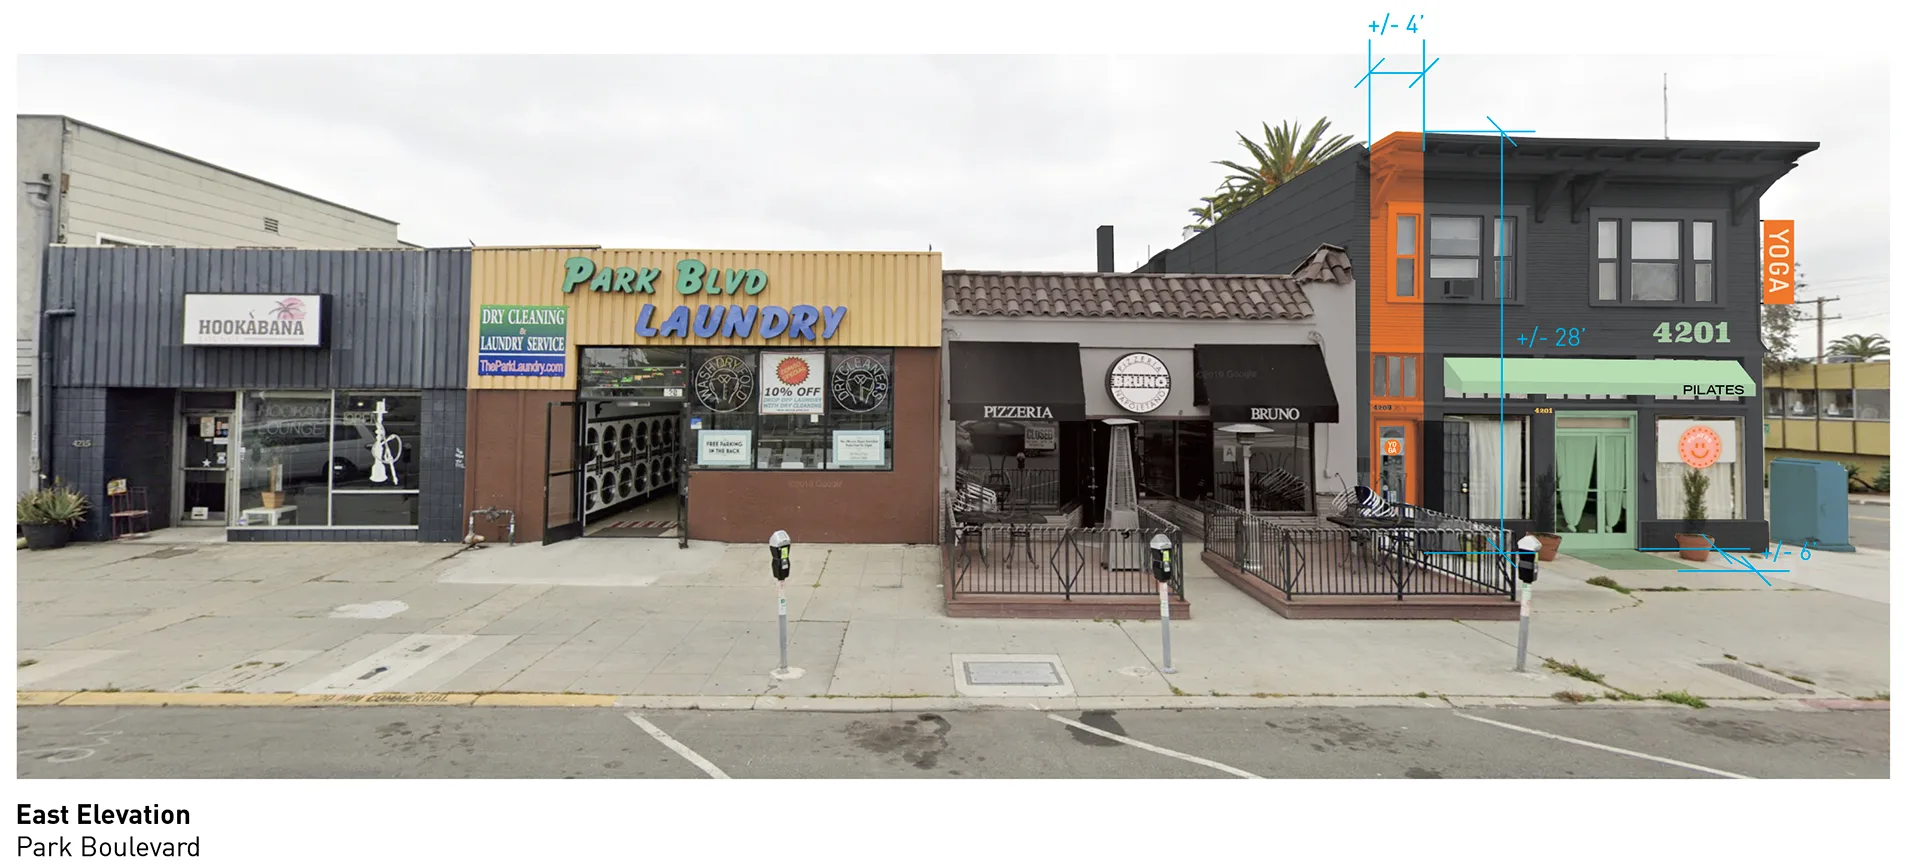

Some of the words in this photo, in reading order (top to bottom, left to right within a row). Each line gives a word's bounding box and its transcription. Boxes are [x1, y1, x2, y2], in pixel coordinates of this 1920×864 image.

[1769, 229, 1789, 292] YOGA
[561, 256, 662, 294] PARK
[676, 258, 769, 295] BLVD
[482, 308, 504, 324] DRY
[508, 308, 564, 325] CLEANING
[634, 304, 847, 341] LAUNDRY
[519, 327, 527, 335] &
[1652, 321, 1730, 343] 4201
[480, 336, 524, 351] LAUNDRY
[527, 336, 564, 351] SERVICE
[480, 359, 563, 375] TheParkLaundry.com
[1117, 356, 1162, 372] PIZZERIA
[698, 362, 716, 401] WASH
[716, 356, 740, 369] DRY
[736, 367, 750, 401] FOLD
[839, 358, 886, 400] CLEANERS
[1112, 376, 1167, 387] BRUNO
[764, 387, 793, 396] 10%
[797, 387, 821, 396] OFF
[834, 375, 849, 401] DRY
[1683, 384, 1744, 395] PILATES
[1115, 390, 1165, 410] NAPOLETANO
[984, 406, 1053, 419] PIZZERIA
[1251, 408, 1300, 420] BRUNO
[258, 422, 326, 436] LOUNGE
[1026, 429, 1053, 440] CLOSED
[1688, 433, 1712, 444] PILATES
[1226, 448, 1233, 456] A
